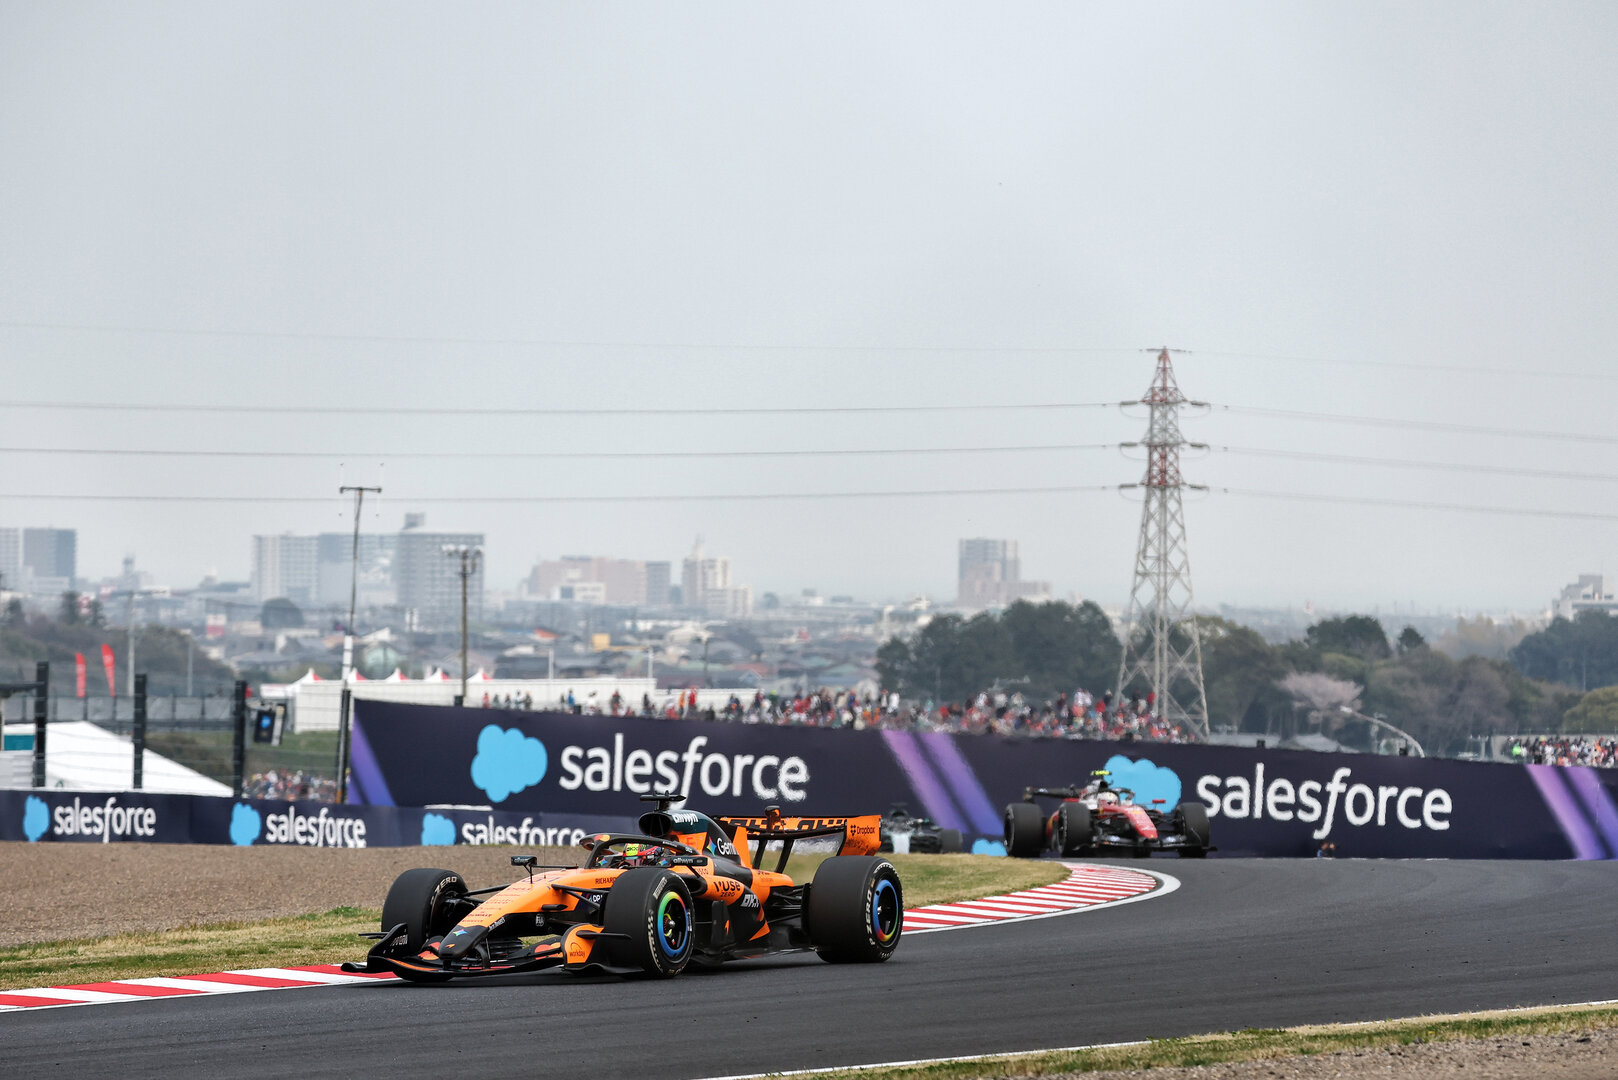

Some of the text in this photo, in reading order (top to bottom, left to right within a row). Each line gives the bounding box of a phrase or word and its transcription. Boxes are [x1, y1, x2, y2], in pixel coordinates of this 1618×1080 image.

[558, 732, 811, 811] salesforce
[53, 797, 156, 843] salesforce
[1195, 761, 1453, 840] salesforce
[265, 806, 367, 848] salesforce
[461, 815, 586, 847] salesforce
[856, 825, 876, 835] Dropbox
